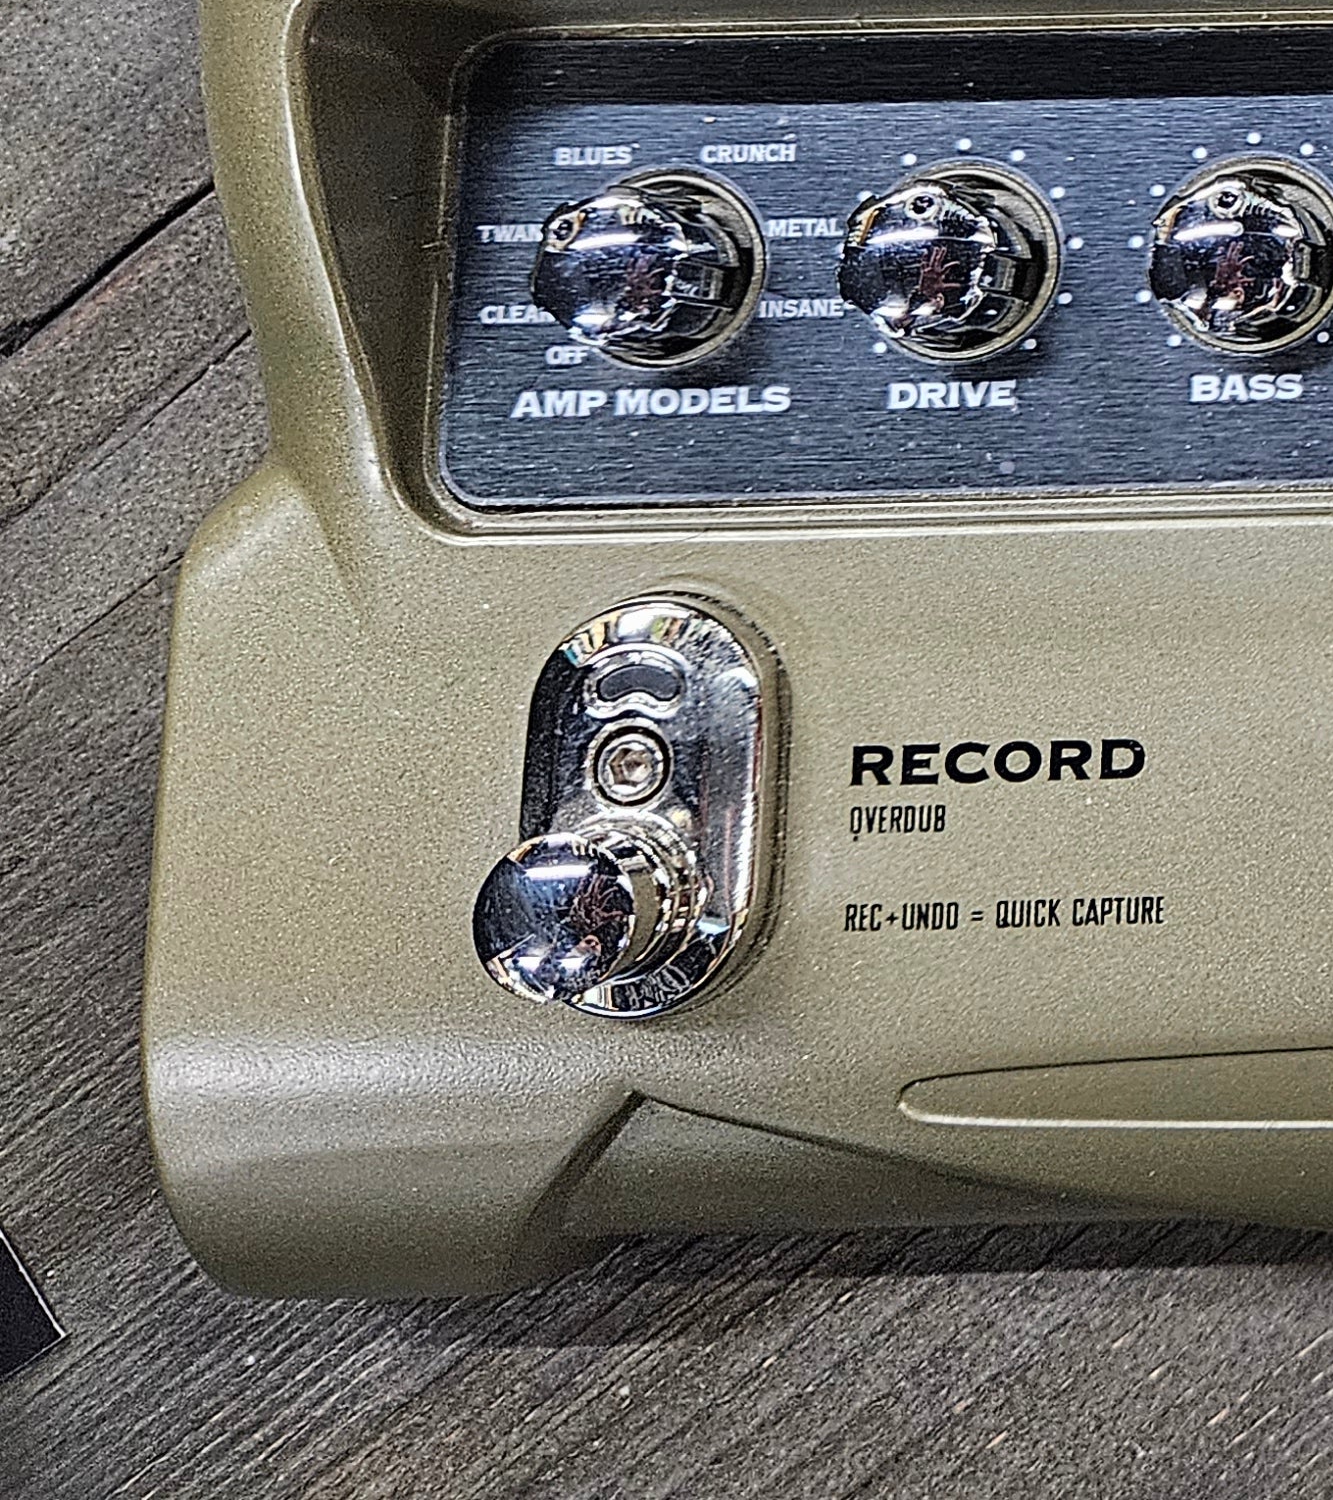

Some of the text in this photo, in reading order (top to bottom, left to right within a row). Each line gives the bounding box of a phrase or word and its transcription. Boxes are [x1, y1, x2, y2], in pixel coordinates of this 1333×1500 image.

[554, 146, 633, 166] BLUES
[701, 143, 797, 163] CRUNCH
[768, 218, 844, 237] METAL
[759, 299, 844, 318] INSANE
[546, 346, 588, 366] OFF
[510, 385, 792, 419] AMP MODELS
[887, 379, 1016, 410] DRIVE
[1190, 374, 1304, 402] BASS
[850, 739, 1146, 786] RECORD
[850, 804, 946, 835] OVERDUB
[844, 901, 959, 932] REC+UNDO
[995, 898, 1061, 928] QUICK
[1072, 896, 1165, 926] CAPTURE
